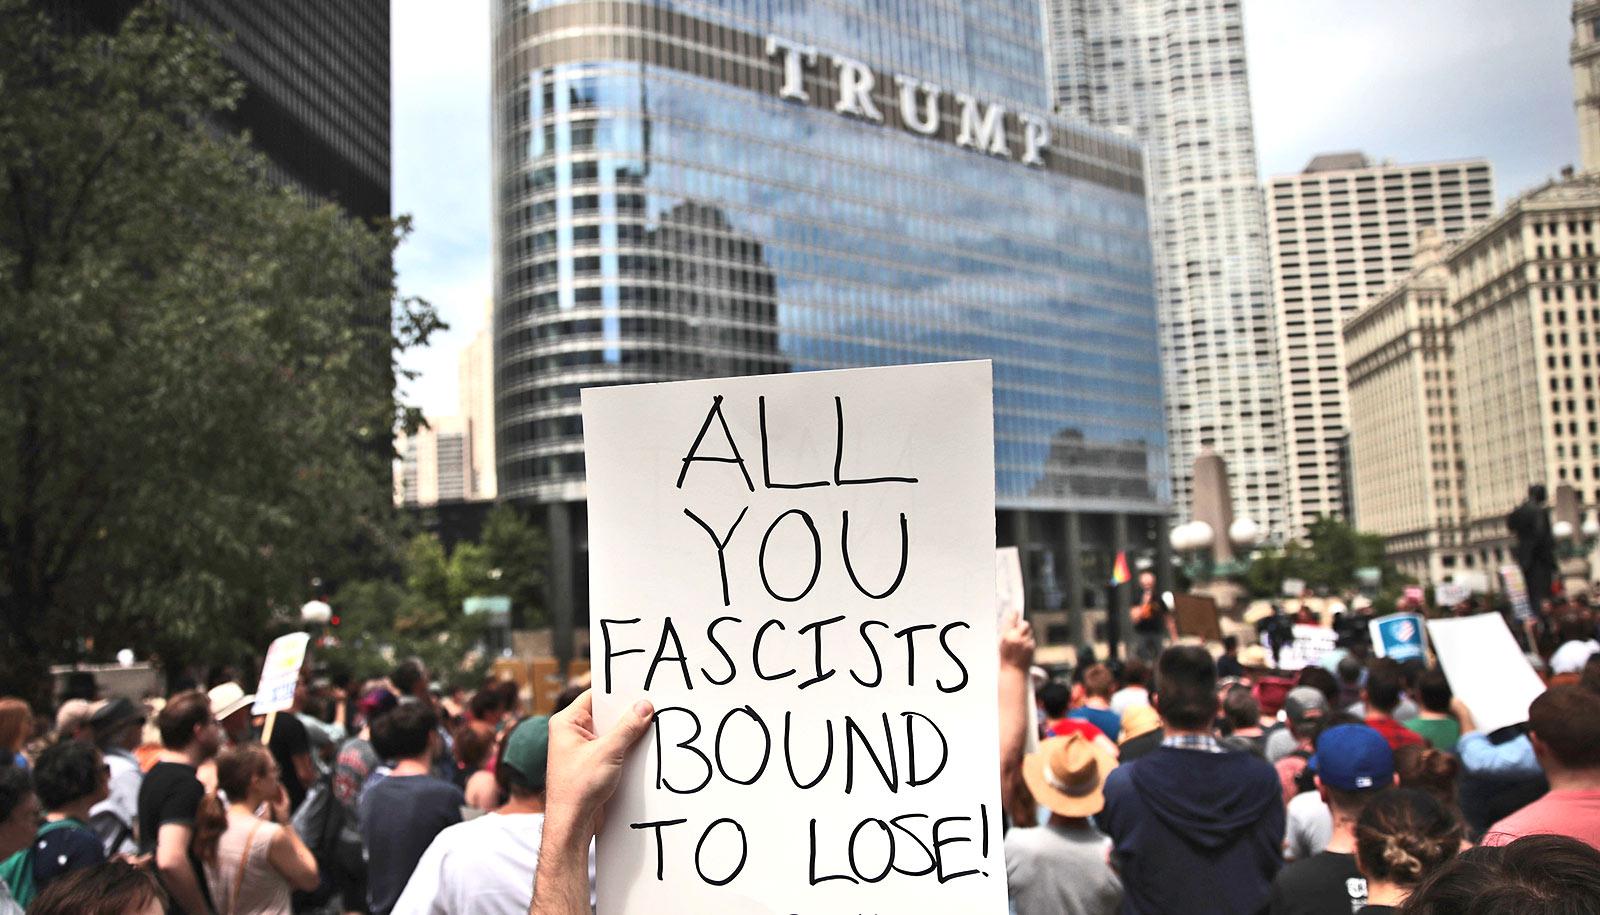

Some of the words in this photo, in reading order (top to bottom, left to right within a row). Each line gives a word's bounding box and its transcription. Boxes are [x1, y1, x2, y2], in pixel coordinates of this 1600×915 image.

[765, 36, 1052, 167] TRUMP
[677, 395, 918, 492] ALL
[684, 506, 908, 606] YOU
[600, 616, 970, 694] FASCISTS
[653, 705, 948, 794] BOUND
[630, 818, 747, 886] TO
[810, 804, 988, 886] LOSE!
